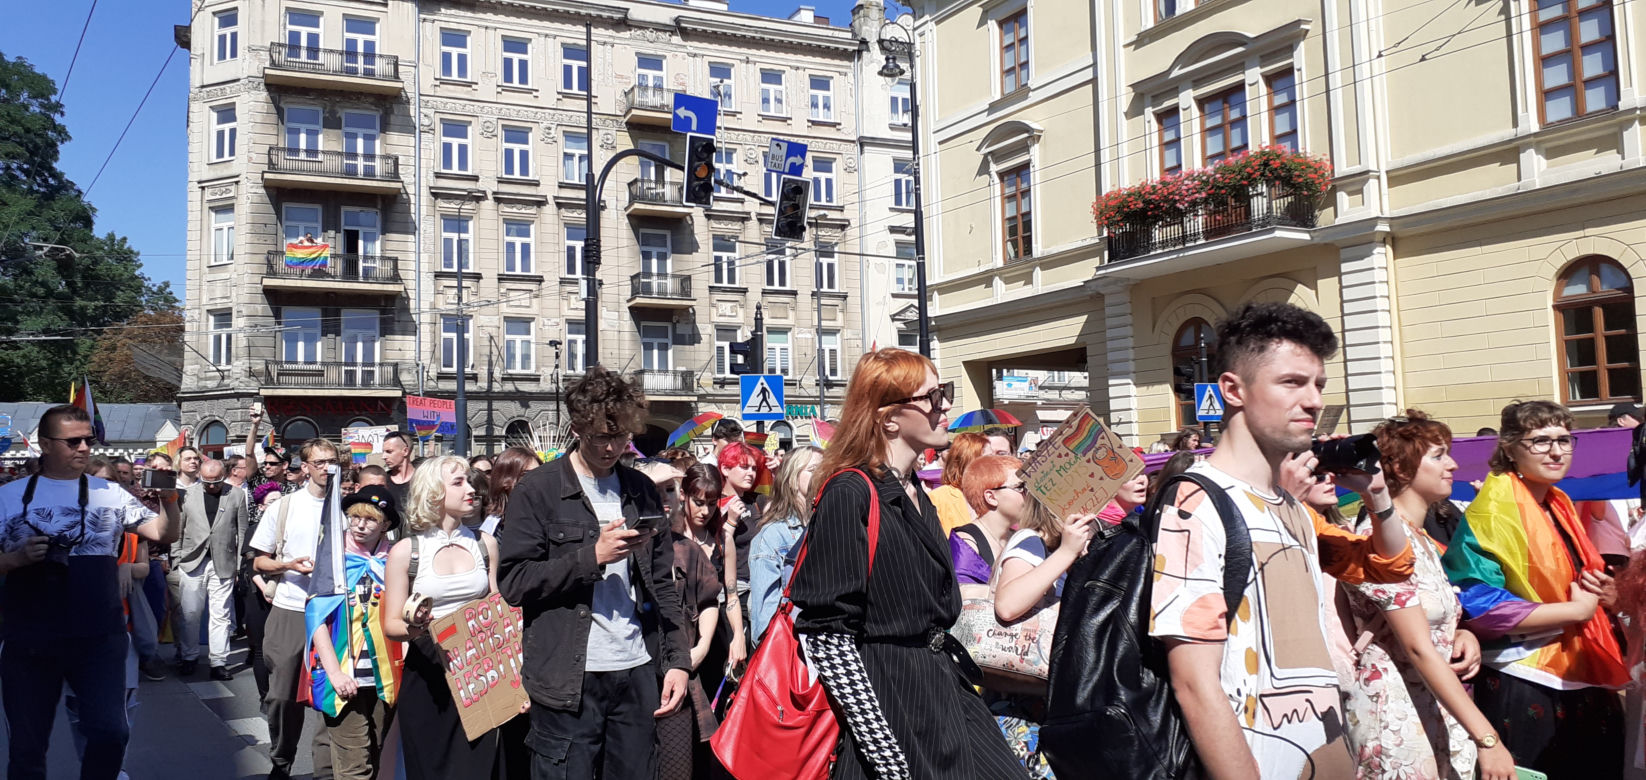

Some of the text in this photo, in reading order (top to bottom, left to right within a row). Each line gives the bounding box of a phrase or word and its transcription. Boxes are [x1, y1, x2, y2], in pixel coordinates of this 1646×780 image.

[771, 153, 784, 162] BUS
[770, 161, 783, 170] TAXI
[408, 396, 453, 410] TREAT PEOPLE
[422, 410, 441, 420] WITH
[1022, 436, 1062, 479] WASZE
[1024, 632, 1038, 644] the
[1001, 643, 1031, 661] world
